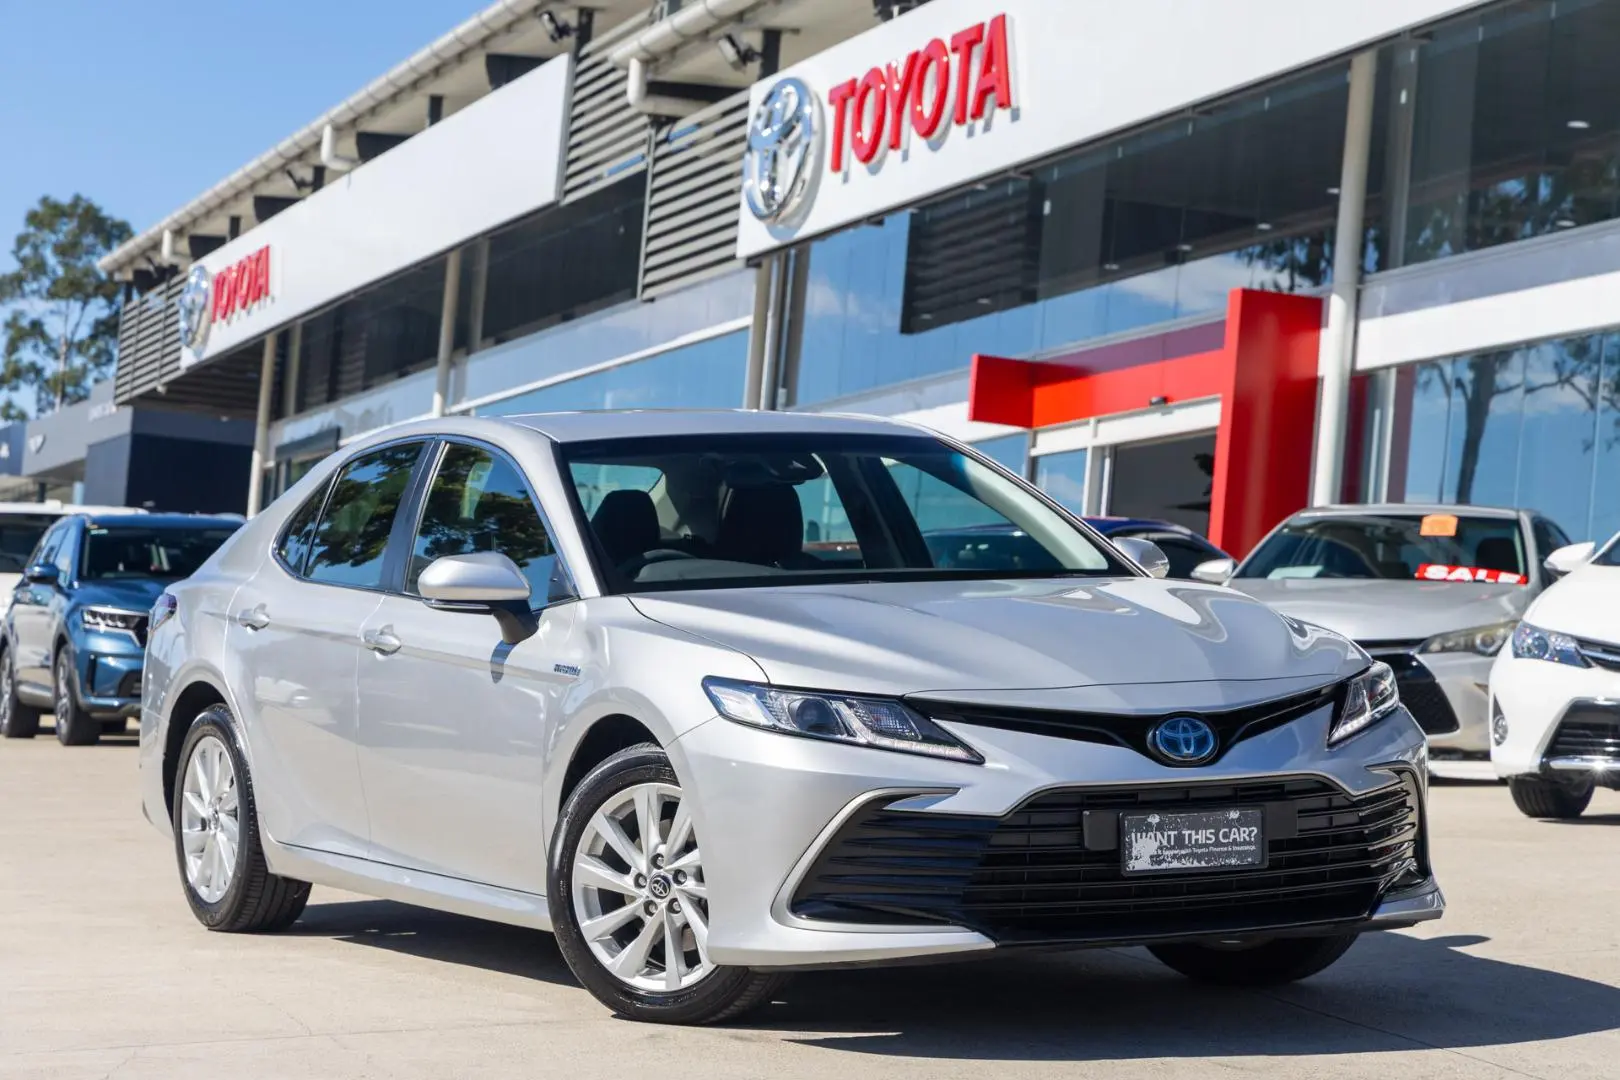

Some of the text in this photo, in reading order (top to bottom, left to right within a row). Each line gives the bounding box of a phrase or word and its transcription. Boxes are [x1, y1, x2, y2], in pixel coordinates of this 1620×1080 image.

[829, 13, 1011, 173] TOYOTA
[211, 245, 270, 324] TOYOTA
[1424, 565, 1521, 584] SALE
[1182, 829, 1216, 845] THIS
[1219, 826, 1258, 843] CAR?
